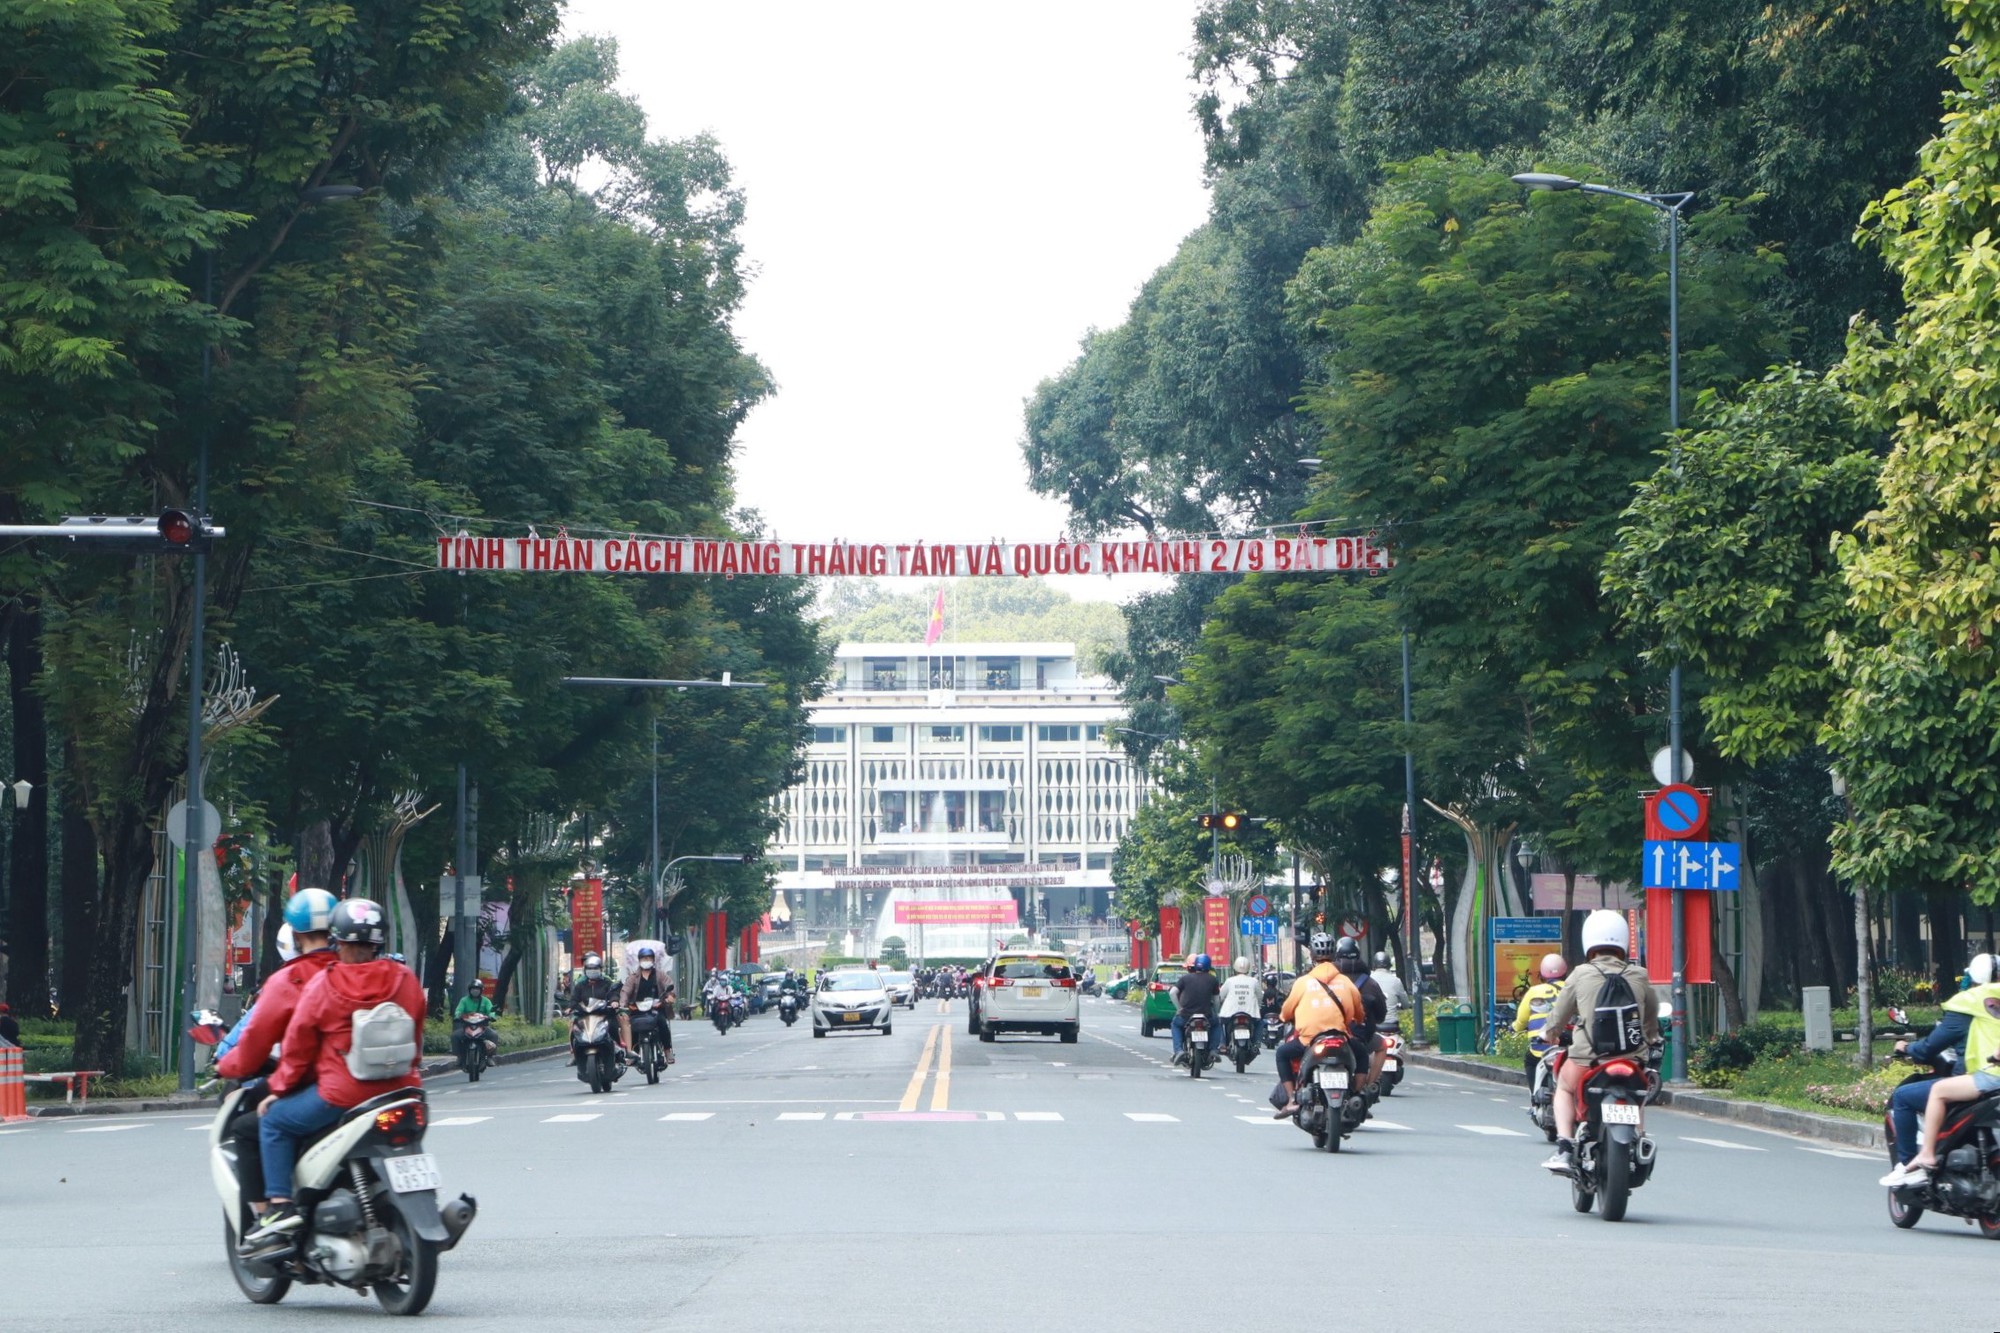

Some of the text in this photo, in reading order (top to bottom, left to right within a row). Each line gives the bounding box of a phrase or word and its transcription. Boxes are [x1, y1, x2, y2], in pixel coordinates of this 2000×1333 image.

[438, 537, 504, 570] TINH
[517, 526, 594, 571] THẦN
[605, 533, 683, 573] CÁCH
[693, 541, 781, 580] MẠNG
[792, 538, 887, 576] THÁNG
[896, 539, 956, 577] TÁM
[966, 537, 1004, 576] VÀ
[1014, 531, 1091, 579] QUỐC
[1102, 533, 1201, 574] KHÁNH
[1211, 539, 1264, 573] 2/9
[1274, 524, 1329, 572] BẤT
